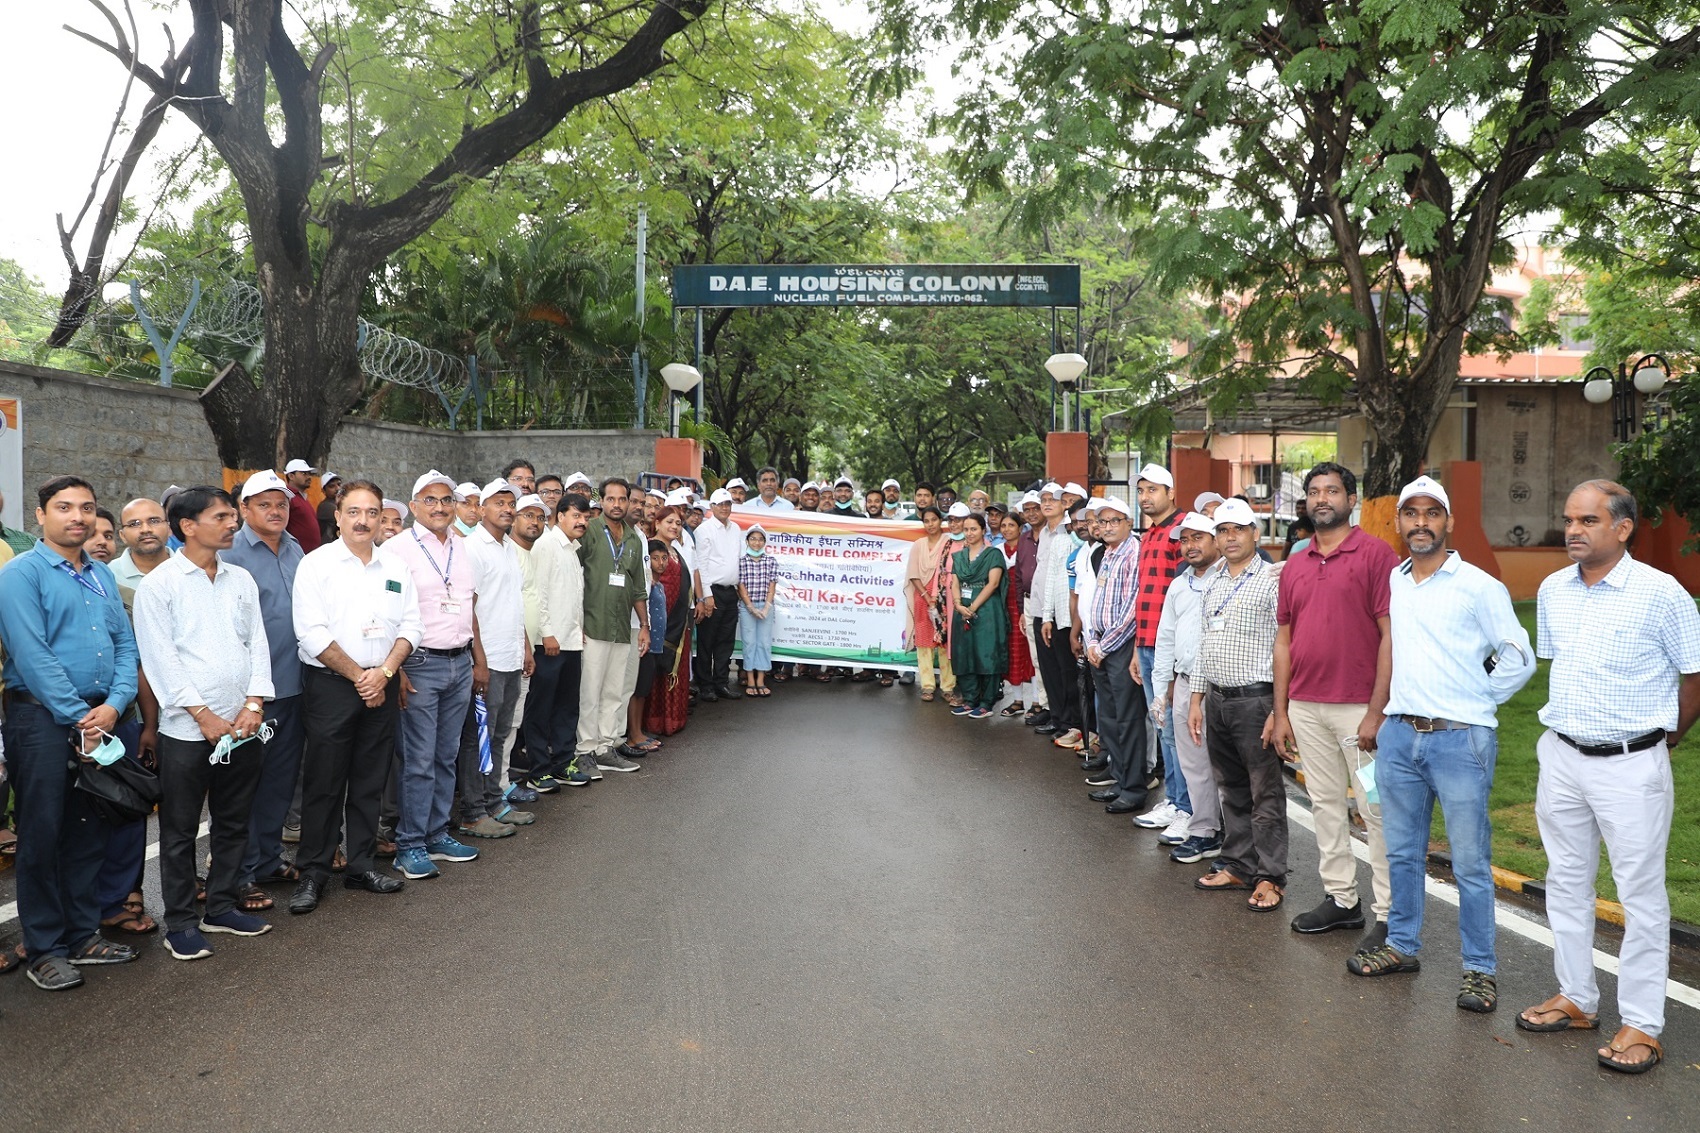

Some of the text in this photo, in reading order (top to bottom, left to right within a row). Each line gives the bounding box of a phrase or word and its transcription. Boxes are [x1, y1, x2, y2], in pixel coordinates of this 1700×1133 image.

[709, 275, 1014, 292] D.A.E. HOUSING COLONY
[774, 293, 830, 303] NUCLEAR
[836, 293, 876, 303] FUEL
[769, 532, 813, 545] नाभिकीय
[764, 545, 804, 556] CLEAR
[808, 548, 838, 558] FUEL
[840, 574, 895, 587] Activities
